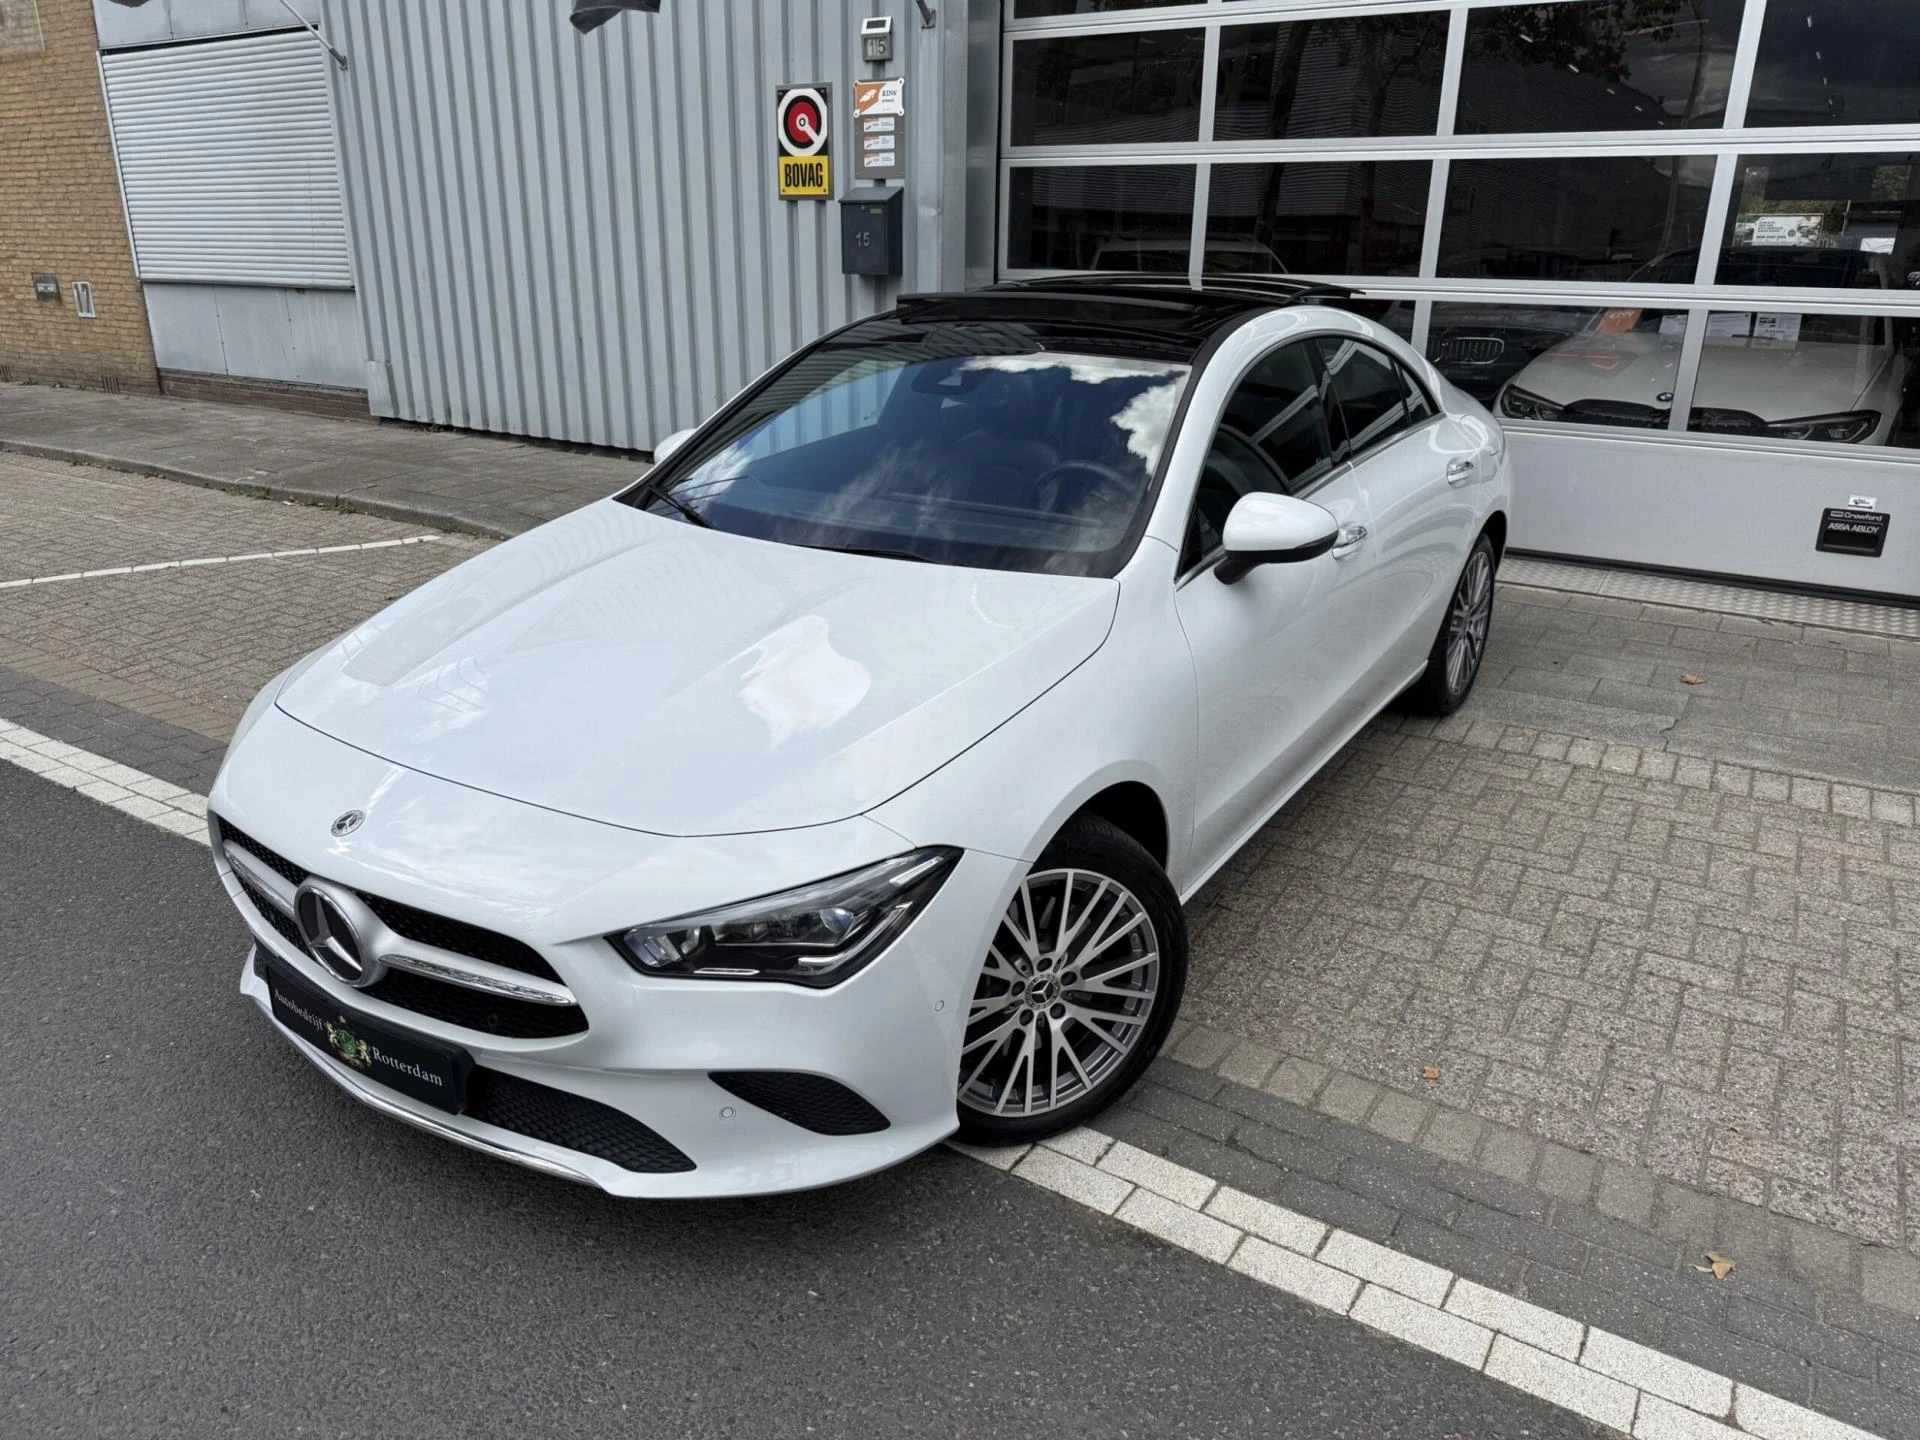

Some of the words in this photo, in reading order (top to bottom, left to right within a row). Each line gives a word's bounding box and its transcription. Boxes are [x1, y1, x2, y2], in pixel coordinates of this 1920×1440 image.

[868, 39, 887, 56] 15
[784, 162, 824, 188] BOVAG
[855, 231, 871, 248] 15
[1844, 511, 1883, 522] Crawford
[1827, 522, 1850, 532] ASSA
[1850, 524, 1880, 534] ABLOY
[274, 988, 323, 1031] Autobedrijf
[371, 1045, 444, 1088] Rotterdam
